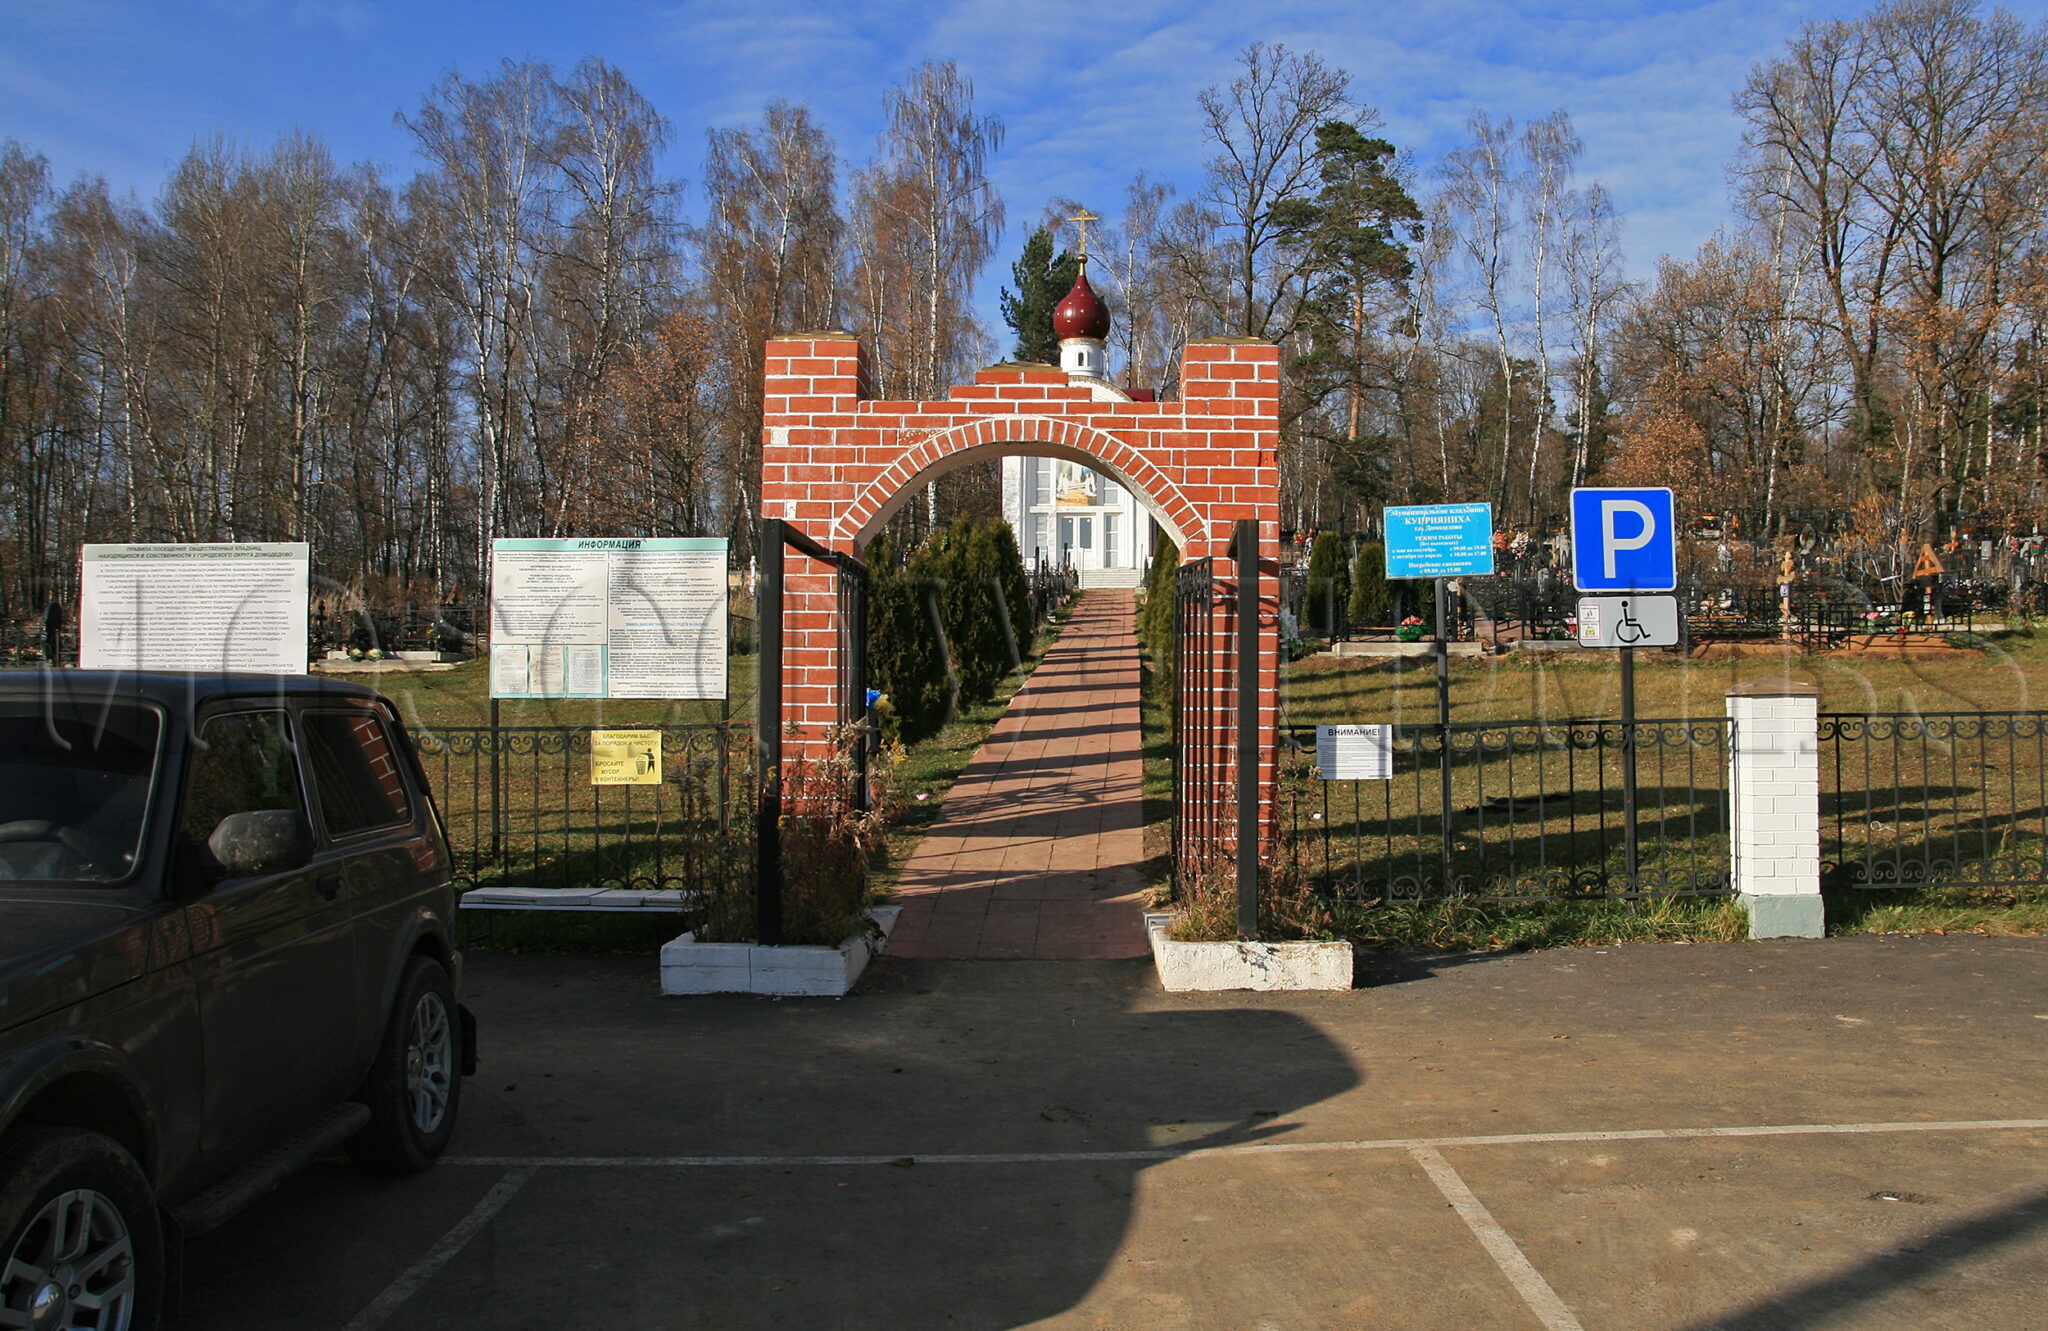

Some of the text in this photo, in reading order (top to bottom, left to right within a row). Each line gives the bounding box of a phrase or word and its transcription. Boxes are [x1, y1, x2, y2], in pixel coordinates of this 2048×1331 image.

[1390, 508, 1448, 517] Муниципальное
[1404, 515, 1471, 526] КУПРИЯНИХА
[1601, 499, 1655, 579] P
[578, 540, 642, 551] ИНФОРМАЦИЯ
[1327, 728, 1381, 736] ВНИМАНИЕ!
[595, 759, 625, 767] БРОСАЙТЕ
